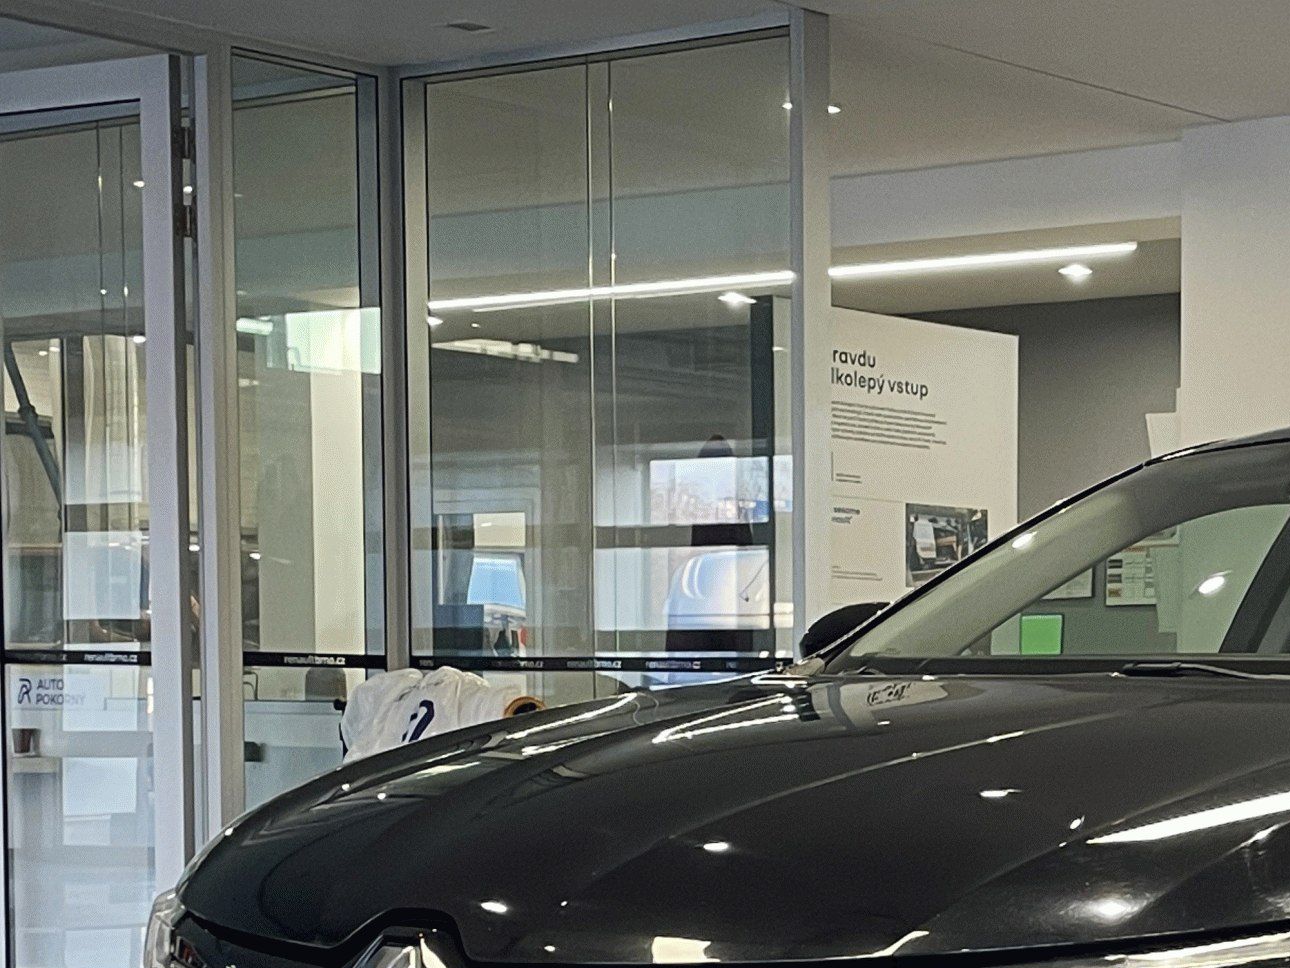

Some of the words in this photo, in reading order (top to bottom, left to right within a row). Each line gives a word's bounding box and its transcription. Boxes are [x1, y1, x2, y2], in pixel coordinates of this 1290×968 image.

[832, 350, 876, 368] ravdu
[888, 380, 929, 400] vstup
[37, 679, 64, 690] AUTO
